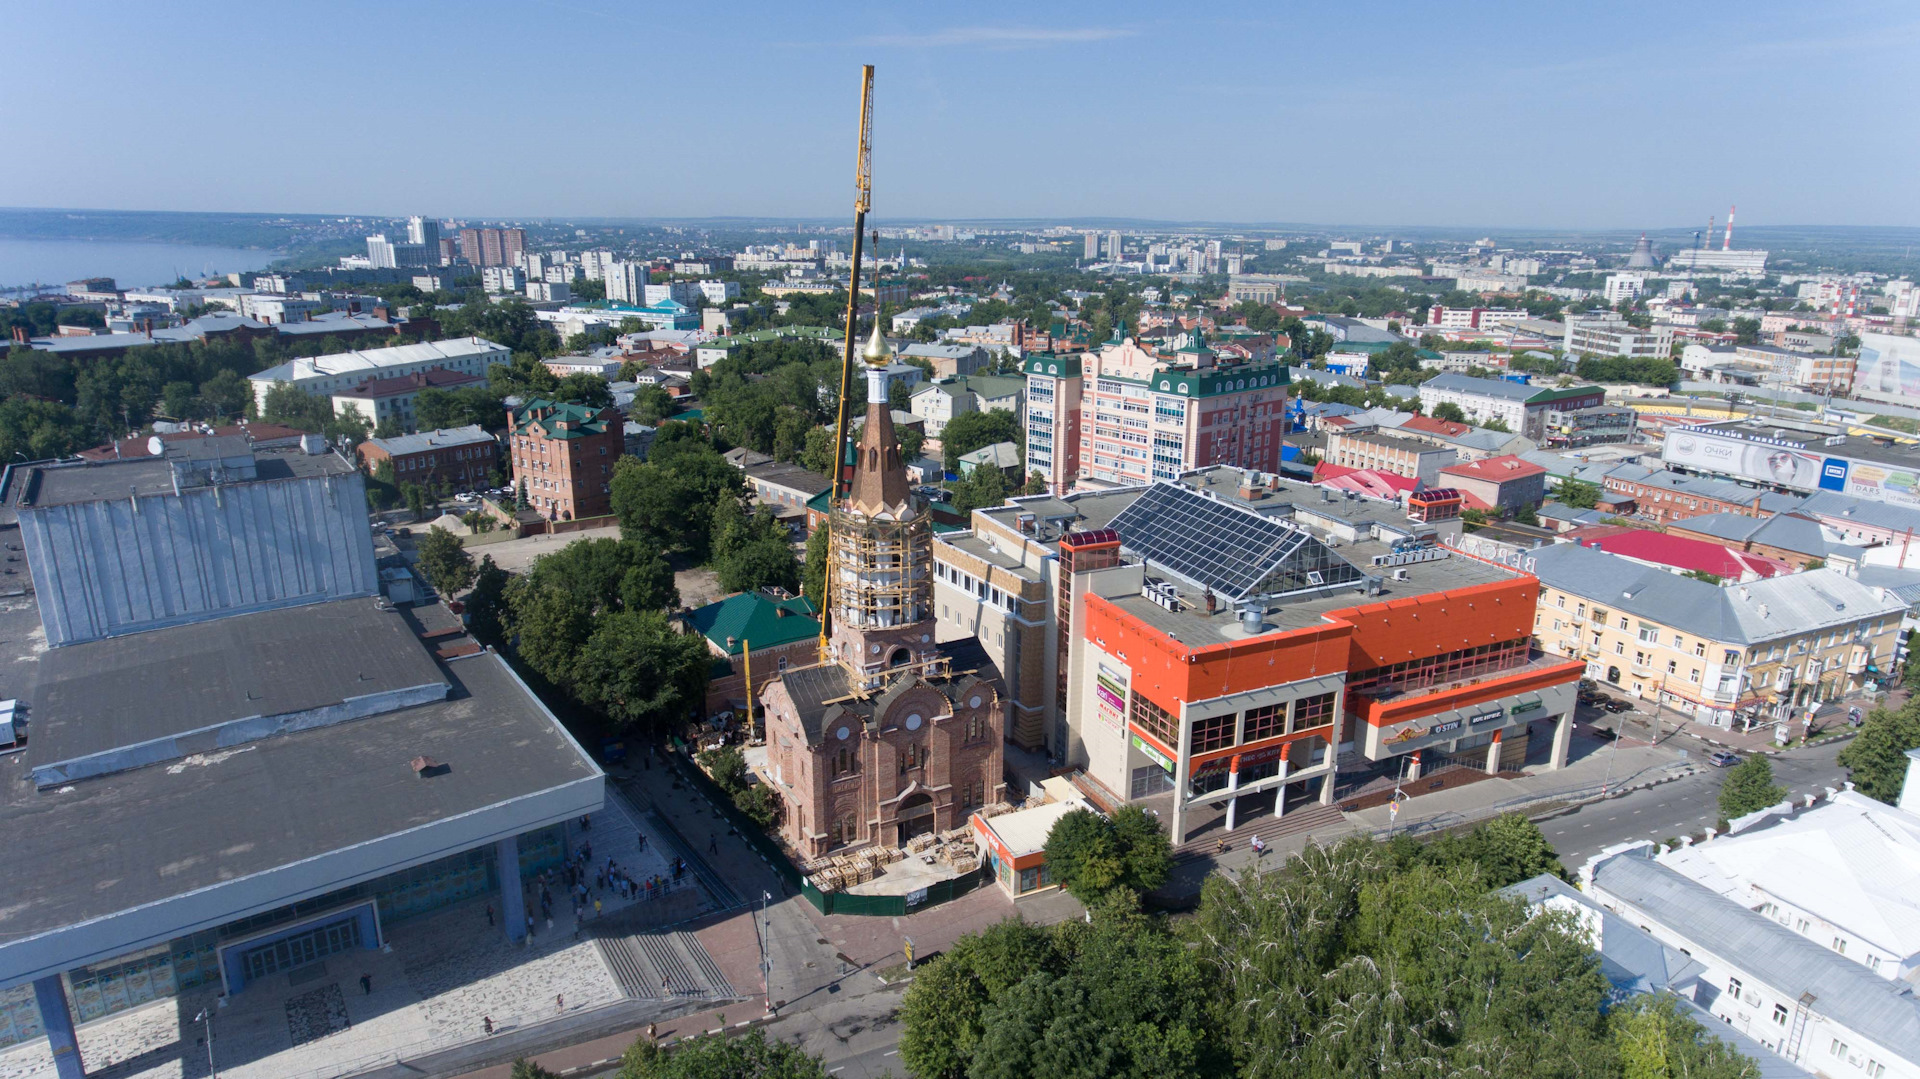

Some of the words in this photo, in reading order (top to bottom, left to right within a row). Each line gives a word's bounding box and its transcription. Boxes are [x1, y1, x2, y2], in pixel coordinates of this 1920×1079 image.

[1749, 435, 1806, 449] УНИВЕРМАГ
[1704, 445, 1732, 457] ОЧКИ
[1855, 485, 1880, 495] DARS
[1097, 685, 1108, 700] kari
[1435, 721, 1459, 734] O'STIN
